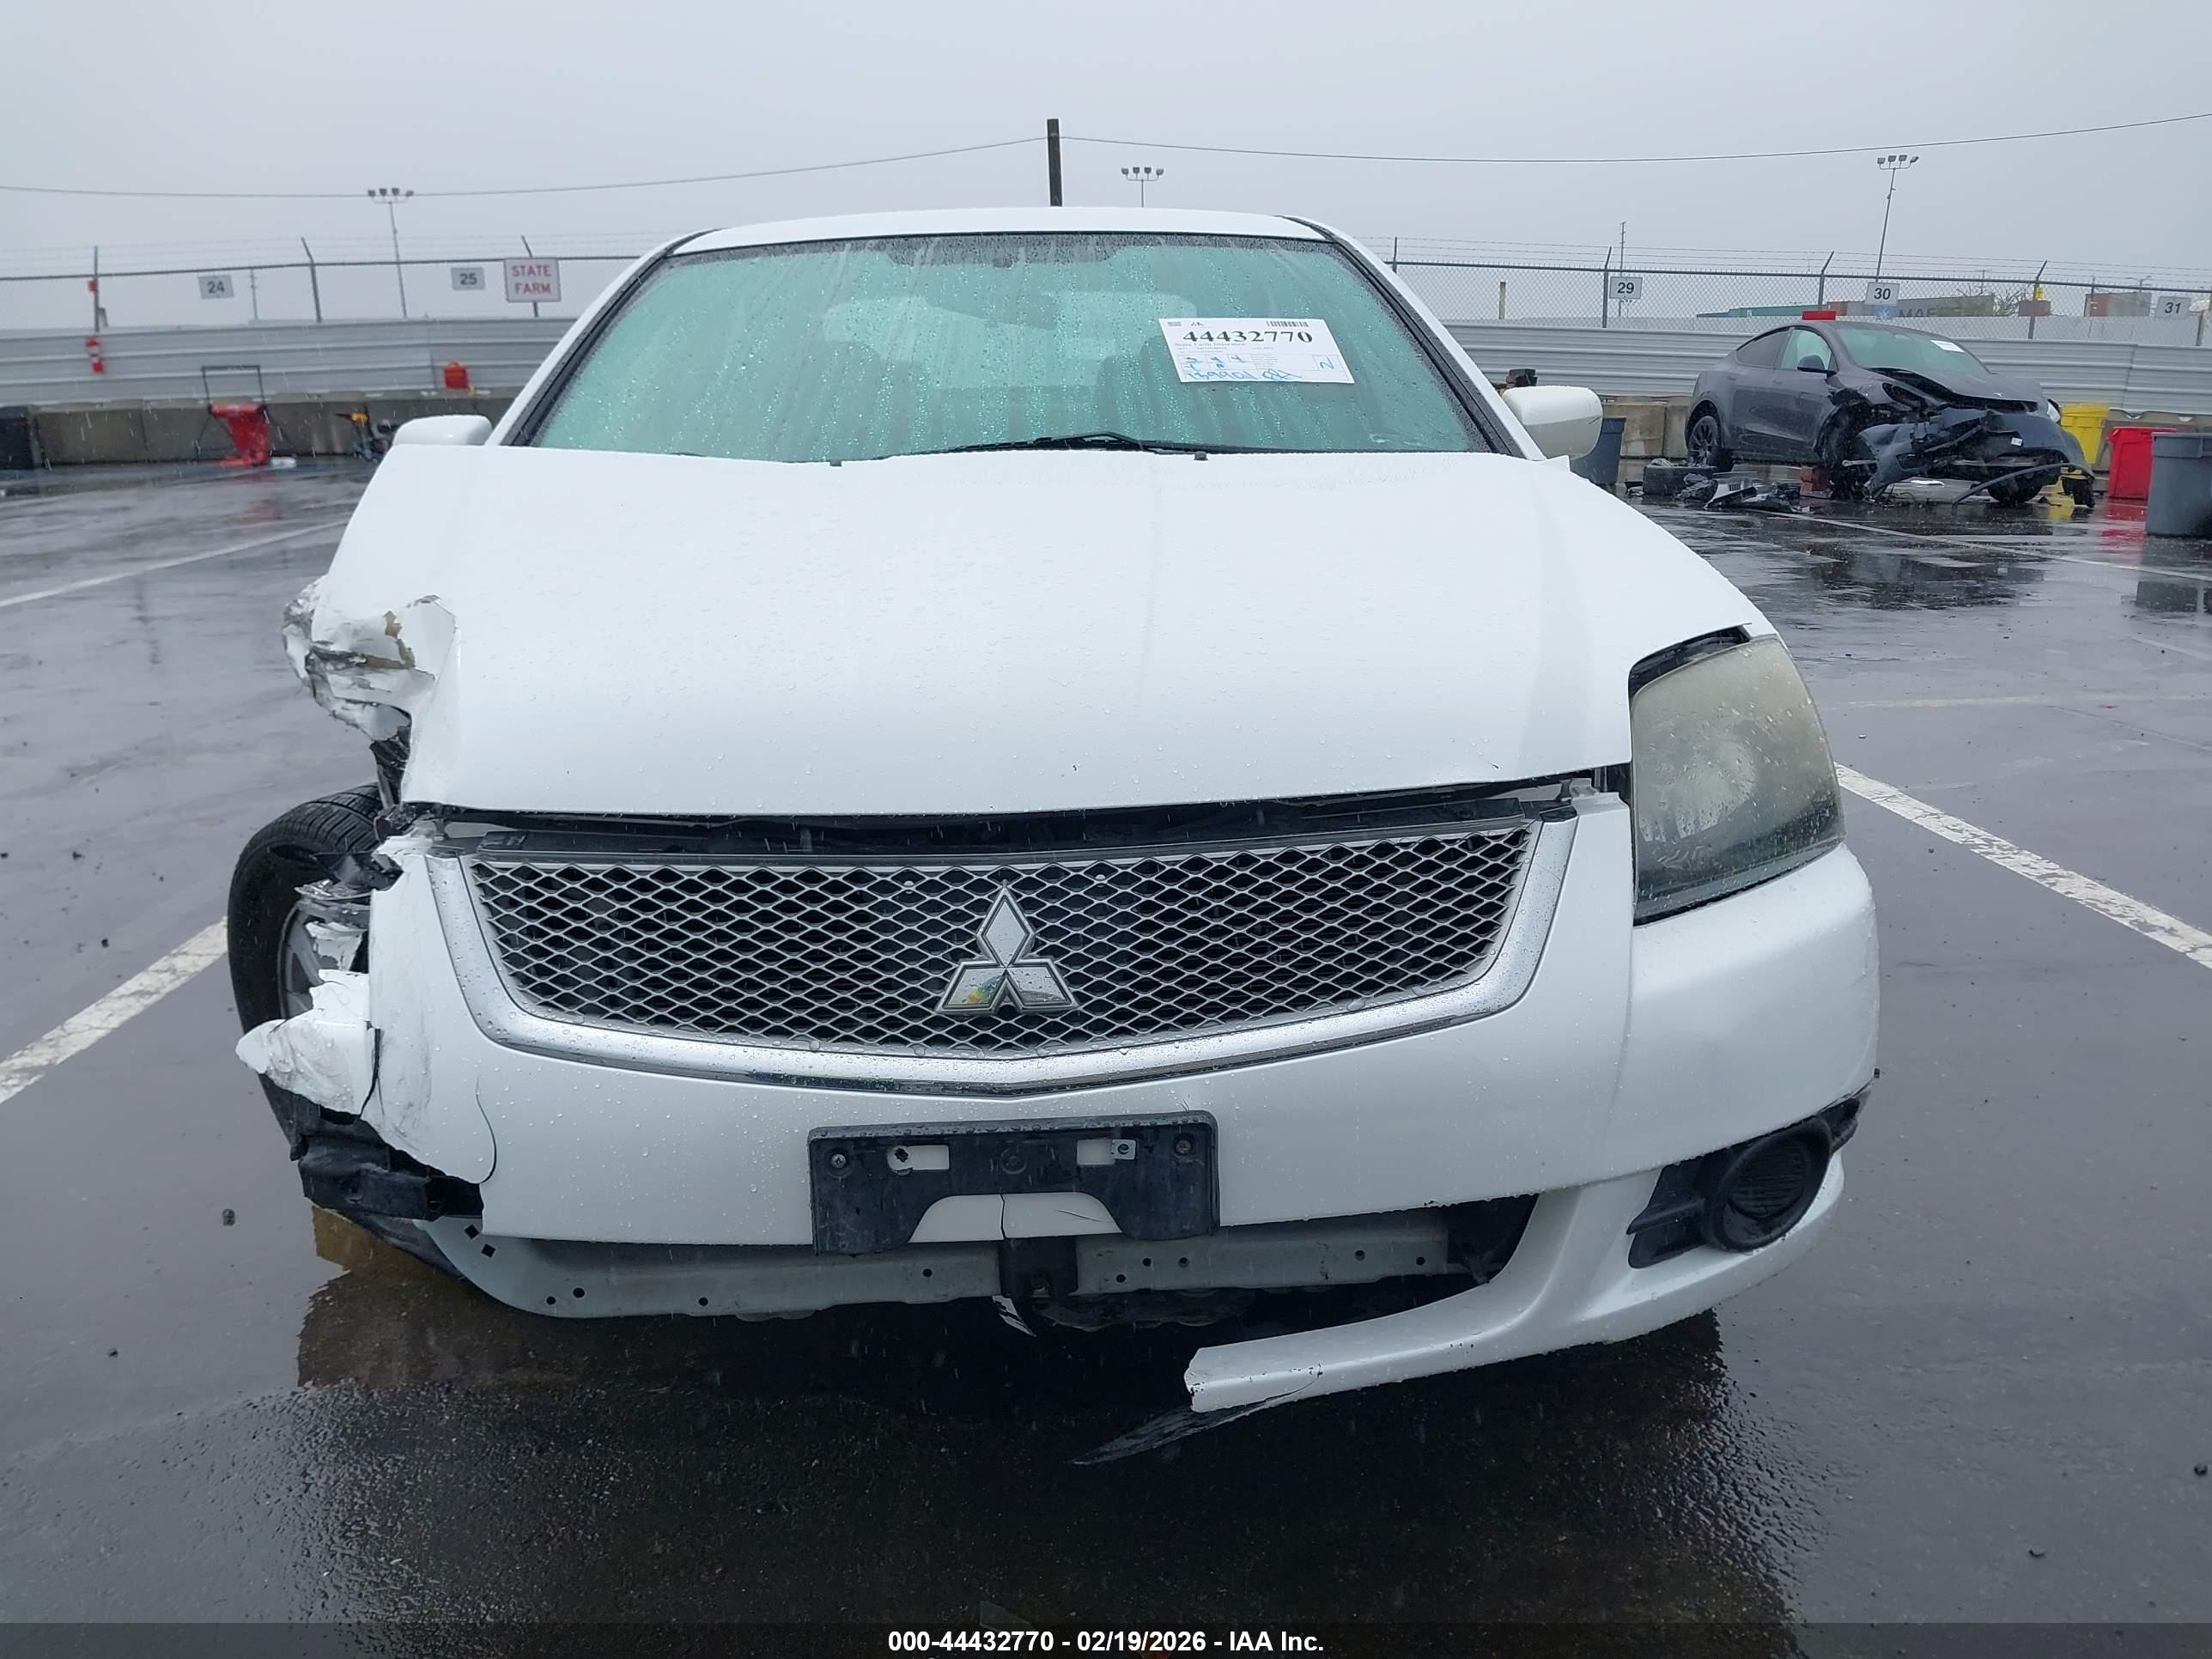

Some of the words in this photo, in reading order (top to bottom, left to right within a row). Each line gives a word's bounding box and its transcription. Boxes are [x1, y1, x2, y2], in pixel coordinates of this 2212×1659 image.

[512, 264, 551, 277] STATE
[459, 272, 477, 285] 25
[207, 280, 225, 294] 24
[514, 283, 551, 295] FARM
[1617, 282, 1635, 295] 29
[1873, 288, 1892, 301] 30
[2164, 301, 2182, 314] 31
[1182, 331, 1314, 343] 44432770
